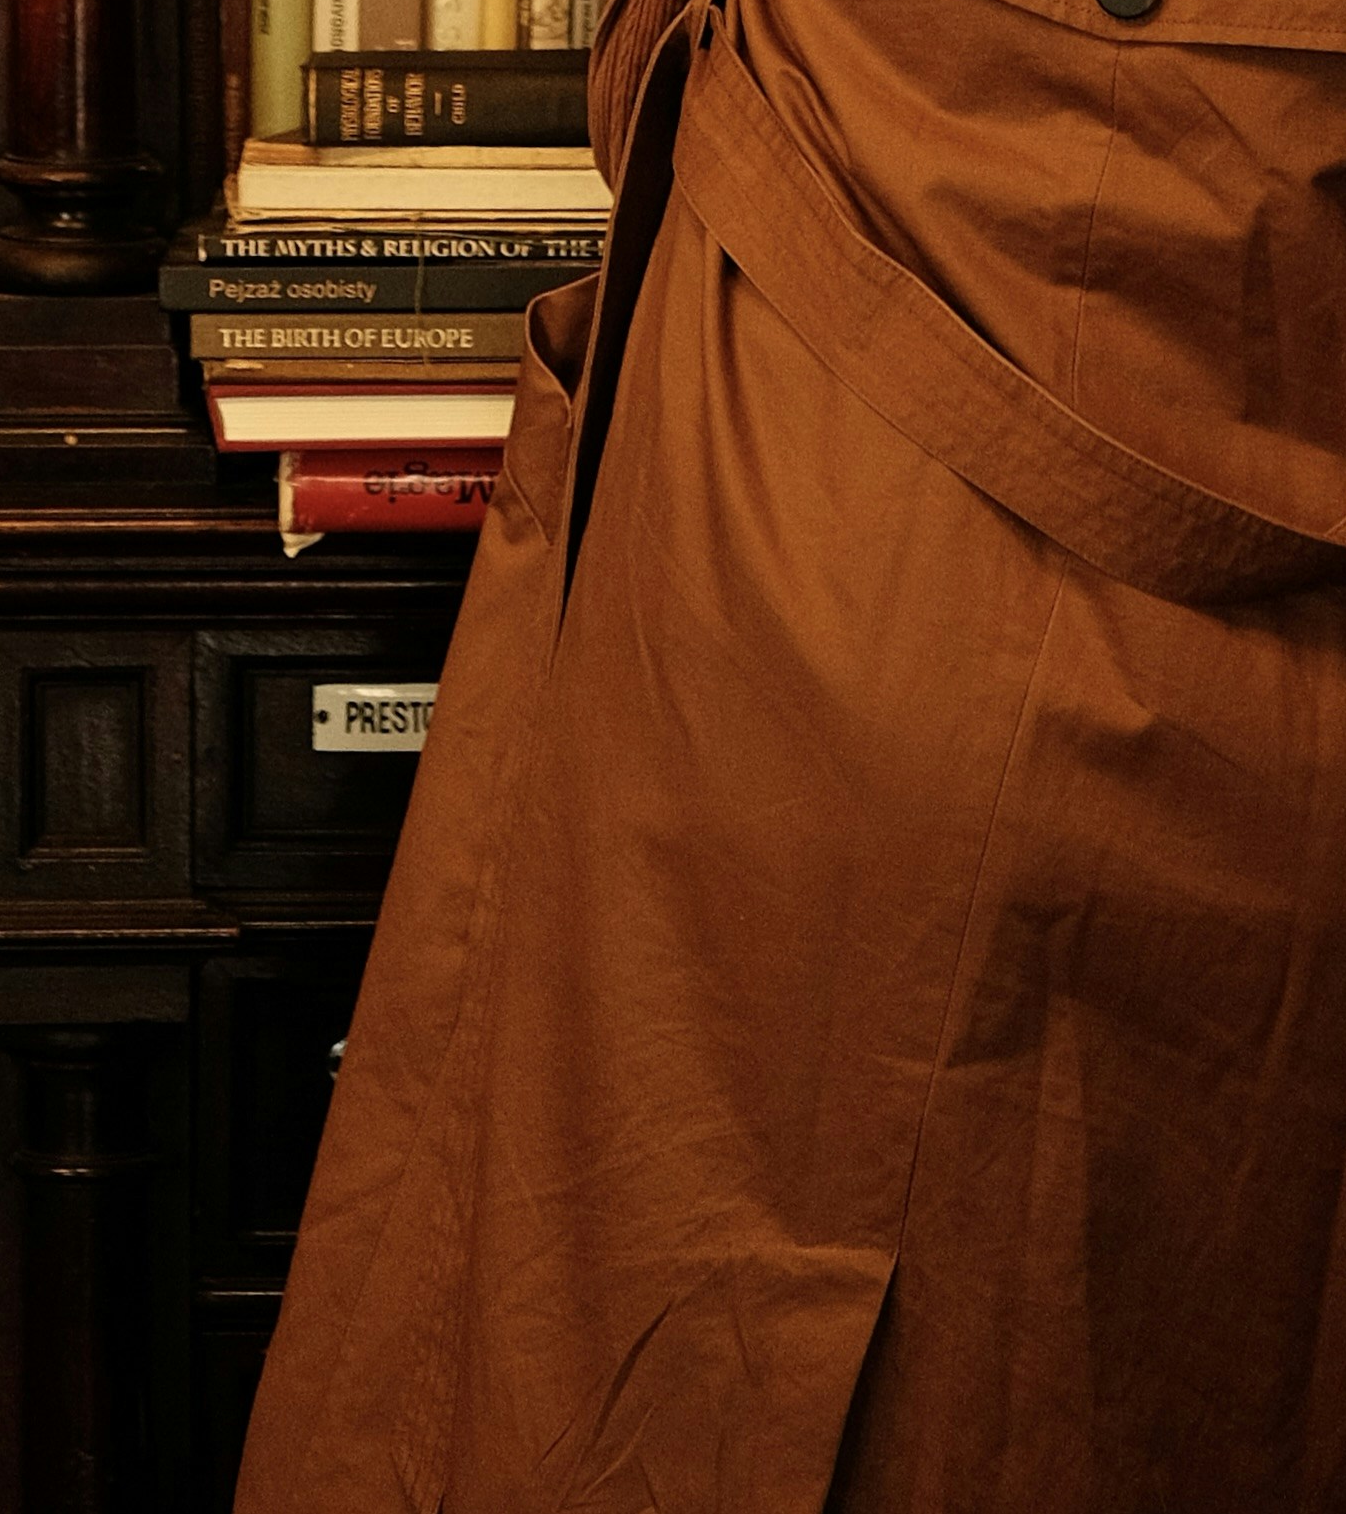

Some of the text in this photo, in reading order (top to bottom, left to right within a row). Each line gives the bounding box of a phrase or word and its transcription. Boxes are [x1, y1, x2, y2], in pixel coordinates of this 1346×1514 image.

[221, 238, 271, 258] THE
[275, 238, 357, 258] MYTHS
[360, 238, 374, 258] &
[383, 237, 496, 258] RELIGION
[500, 238, 533, 258] OF
[208, 277, 378, 304] Pejzaż osobisty
[219, 327, 475, 350] THE BIRTH OF EUROPE
